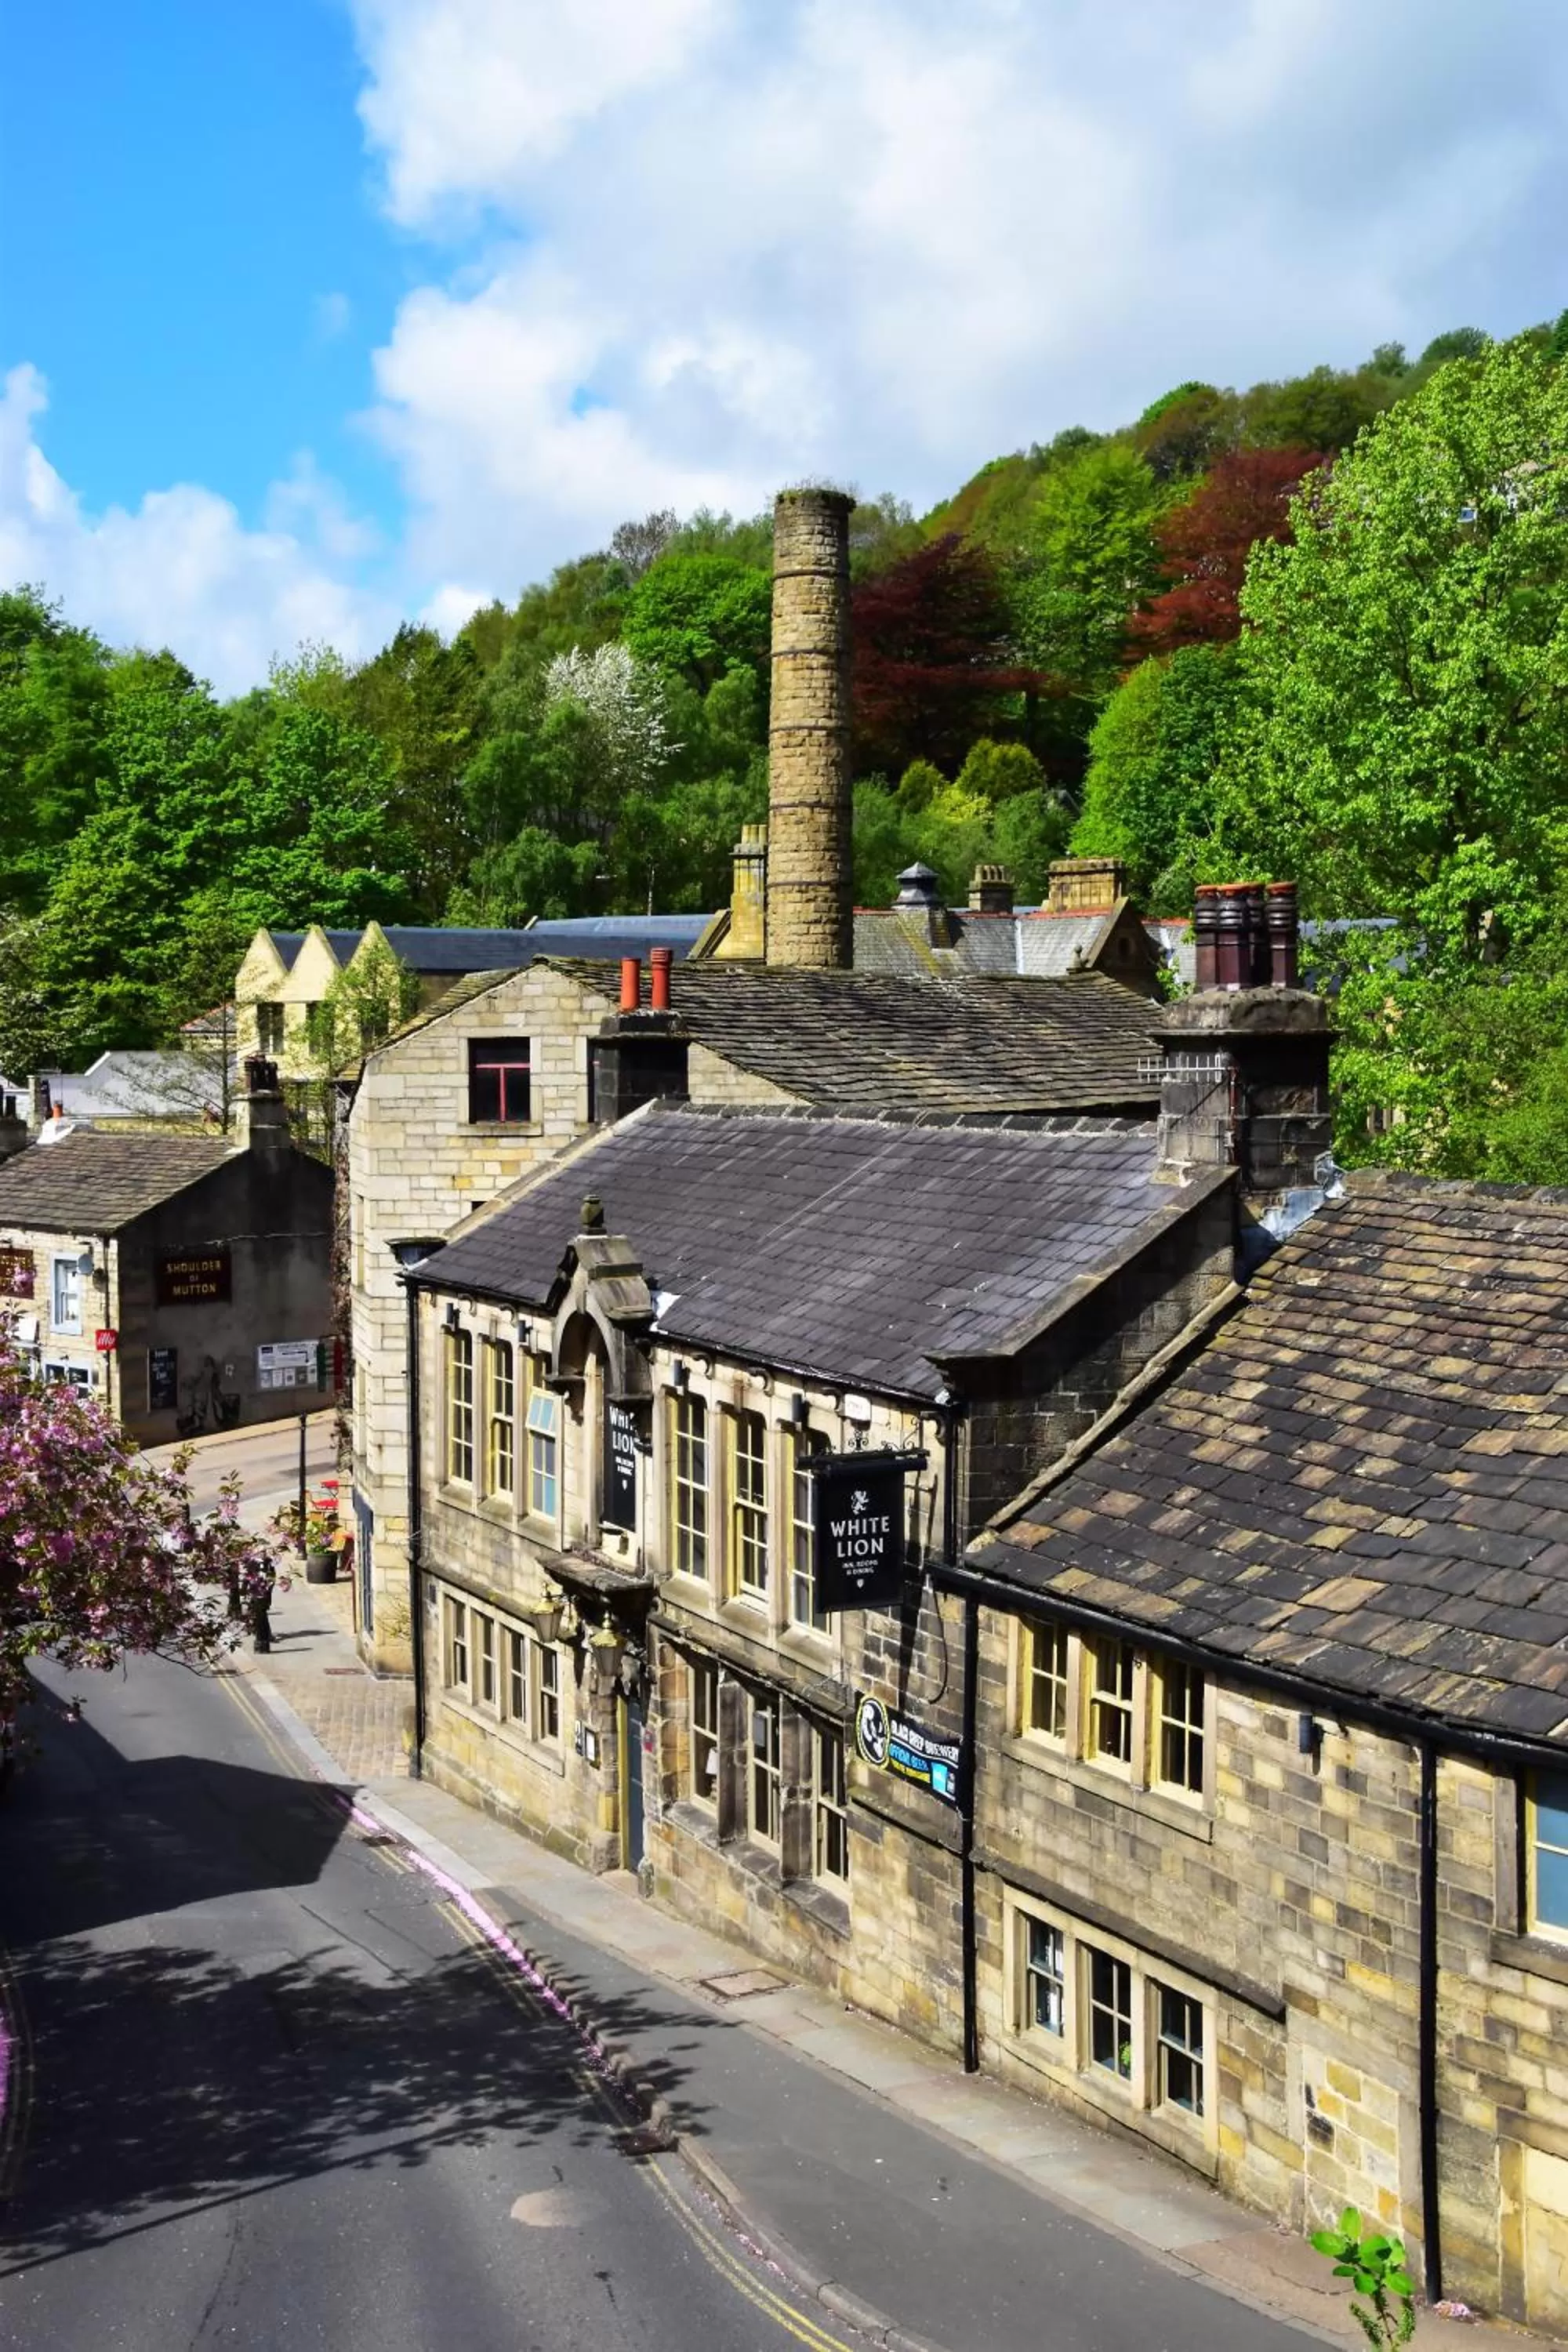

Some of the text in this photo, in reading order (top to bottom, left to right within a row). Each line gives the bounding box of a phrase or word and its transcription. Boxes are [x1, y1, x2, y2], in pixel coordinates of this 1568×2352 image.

[166, 1260, 221, 1274] SHOULDER
[172, 1283, 217, 1296] MUTTON
[830, 1515, 890, 1537] WHITE
[837, 1537, 884, 1558] LION
